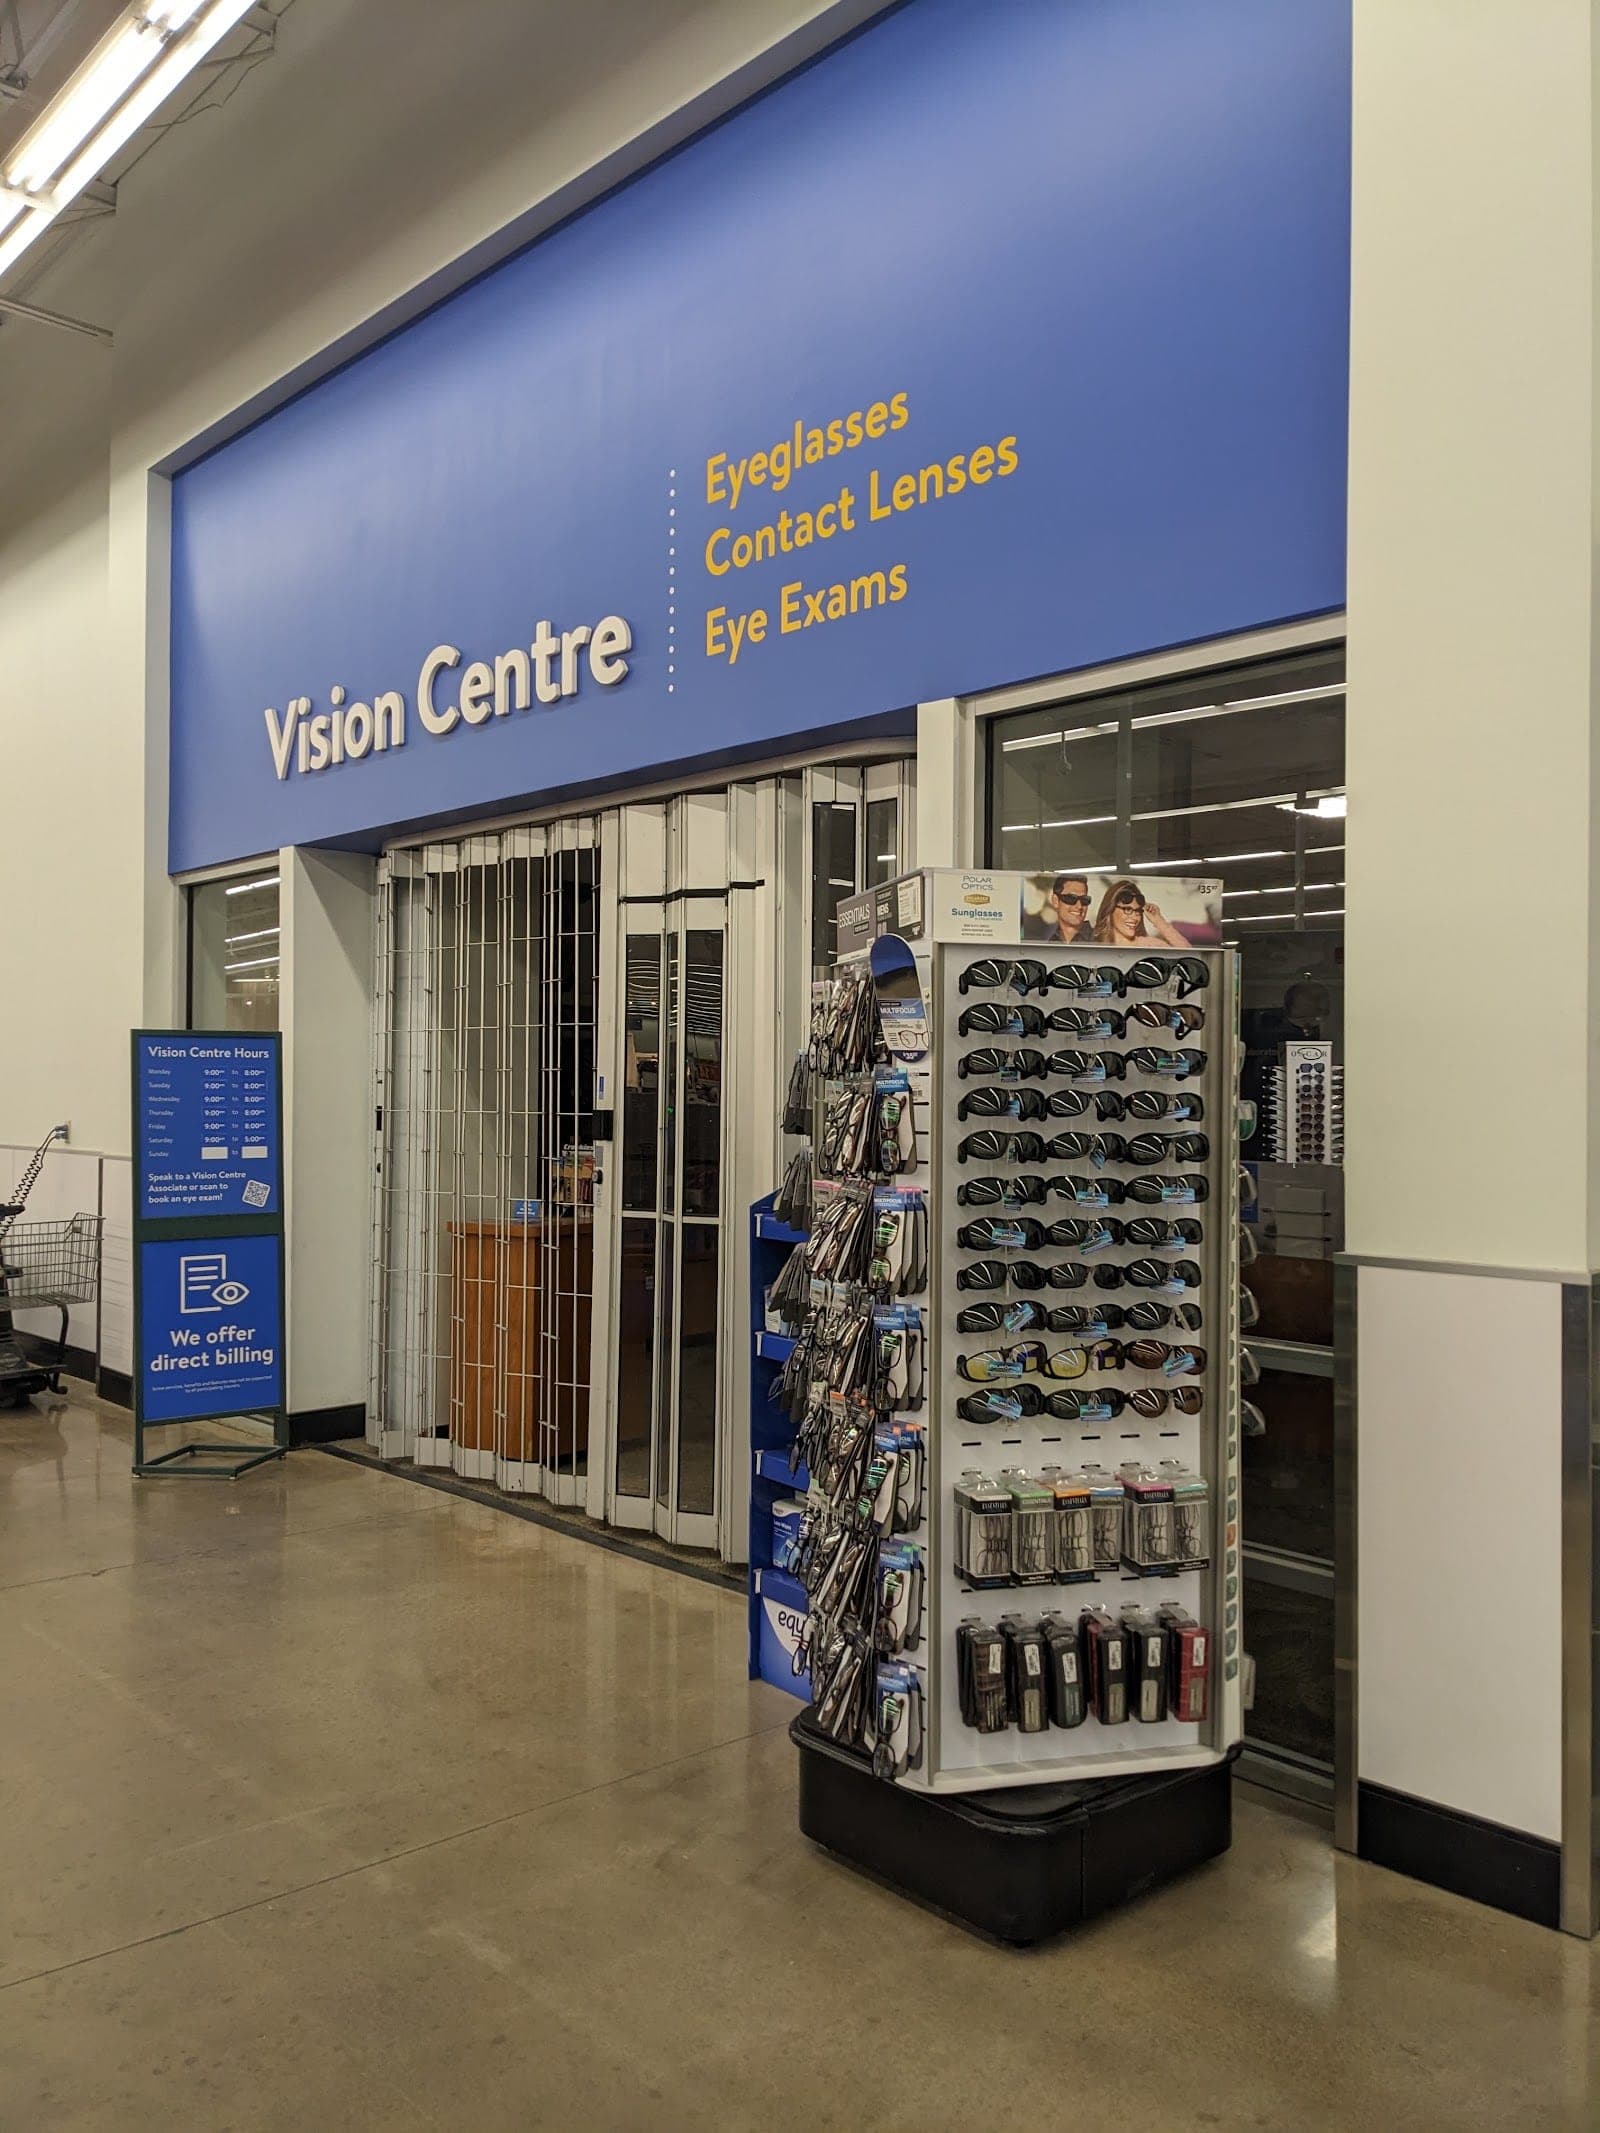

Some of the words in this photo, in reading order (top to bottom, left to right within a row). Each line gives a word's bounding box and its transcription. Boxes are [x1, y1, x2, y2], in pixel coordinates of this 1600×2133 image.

[707, 392, 909, 509] Eyeglasses
[705, 487, 855, 576] Contact
[870, 436, 1019, 521] Lenses
[707, 602, 766, 664] Eye
[781, 563, 908, 634] Exams
[265, 685, 405, 780] Vision
[417, 615, 632, 735] Centre
[839, 904, 871, 929] ESSENTIALS
[951, 908, 1003, 918] Sunglasses
[880, 1006, 916, 1015] MULTIFOCUS
[148, 1046, 186, 1058] Vision
[190, 1047, 231, 1058] Centre
[234, 1047, 269, 1059] Hours
[148, 1173, 173, 1182] Speak
[192, 1171, 217, 1179] Vision
[218, 1170, 247, 1179] Centre
[148, 1184, 188, 1192] Associate
[148, 1195, 170, 1204] book
[182, 1196, 197, 1204] eye
[198, 1193, 223, 1201] exam!
[170, 1329, 201, 1347] We
[206, 1325, 256, 1344] offer
[150, 1352, 210, 1372] direct
[215, 1346, 274, 1365] billing
